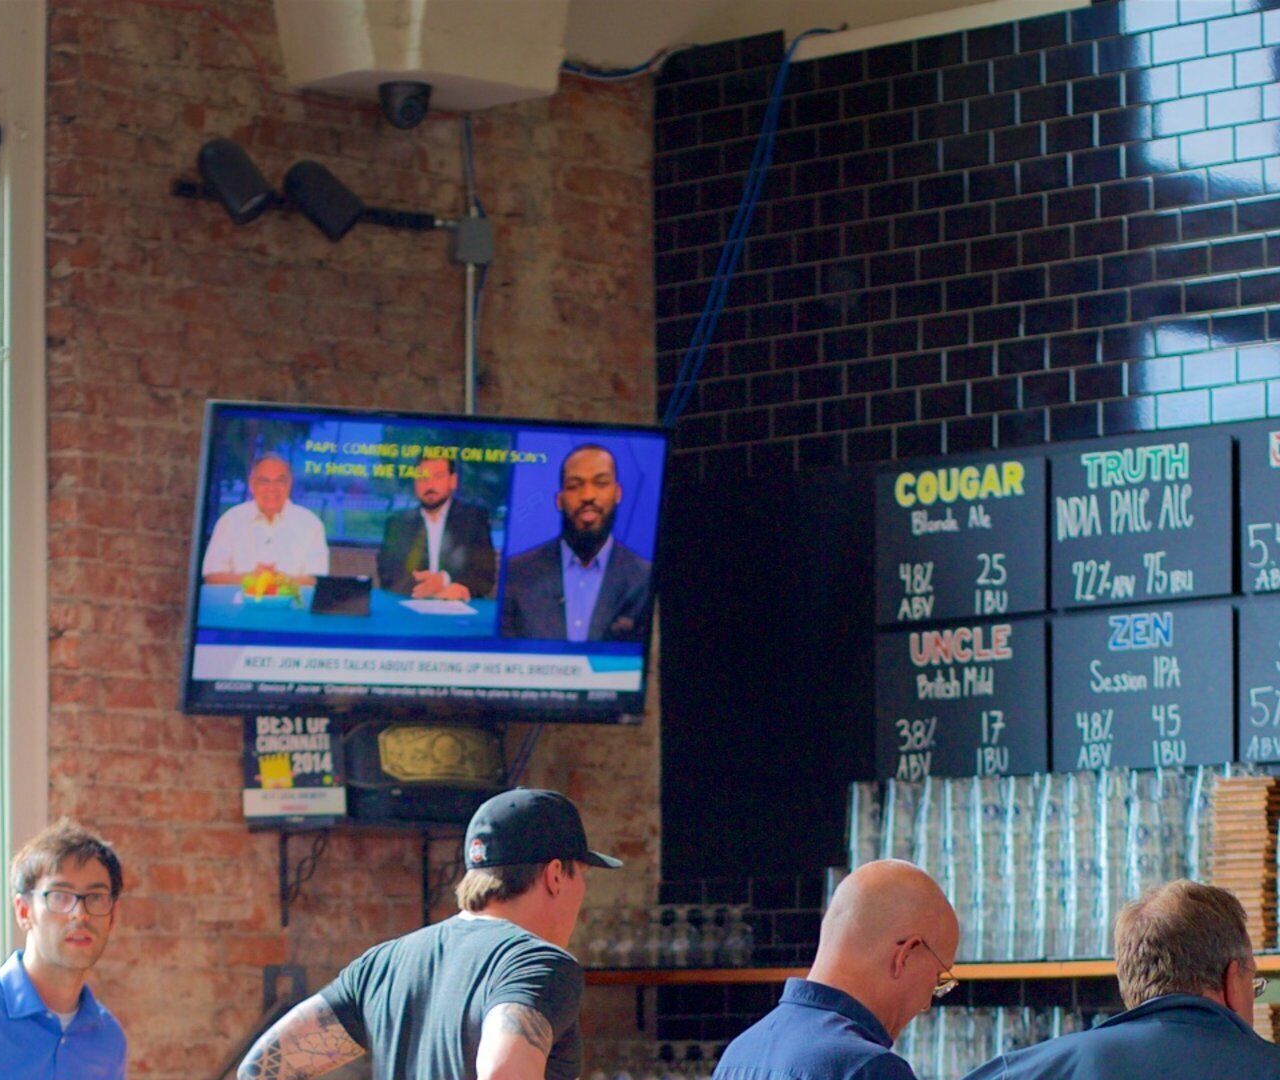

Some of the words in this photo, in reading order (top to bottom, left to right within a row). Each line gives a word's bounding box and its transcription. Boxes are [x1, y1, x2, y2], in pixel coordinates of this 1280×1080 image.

[305, 460, 323, 474] TV
[373, 463, 395, 478] WE
[343, 442, 397, 458] COMING
[401, 444, 421, 458] UP
[423, 445, 460, 460] NEXT
[461, 447, 482, 462] ON
[485, 448, 507, 463] MY
[1081, 442, 1190, 489] TRUTH
[894, 460, 1025, 507] COUGAR
[976, 553, 1007, 586] 25
[1144, 551, 1169, 595] 75
[897, 595, 935, 621] ABV
[974, 590, 1008, 615] IBU
[909, 624, 1013, 667] UNCLE
[1108, 611, 1173, 651] ZEN
[279, 657, 301, 670] JON
[304, 658, 340, 671] JONES
[344, 658, 376, 671] TALKS
[380, 659, 415, 672] ABOUT
[418, 660, 462, 673] BEATING
[468, 662, 482, 674] UP
[483, 662, 501, 674] HIS
[505, 662, 525, 675] NFL
[1090, 659, 1147, 694] Session
[1153, 655, 1182, 689] IPA
[981, 710, 1006, 745] 17
[1152, 704, 1182, 737] 45
[292, 752, 332, 774] 2014
[896, 752, 932, 782] ABV
[976, 747, 1009, 776] IBU
[1077, 743, 1112, 770] ABV
[1152, 739, 1187, 766] IBU
